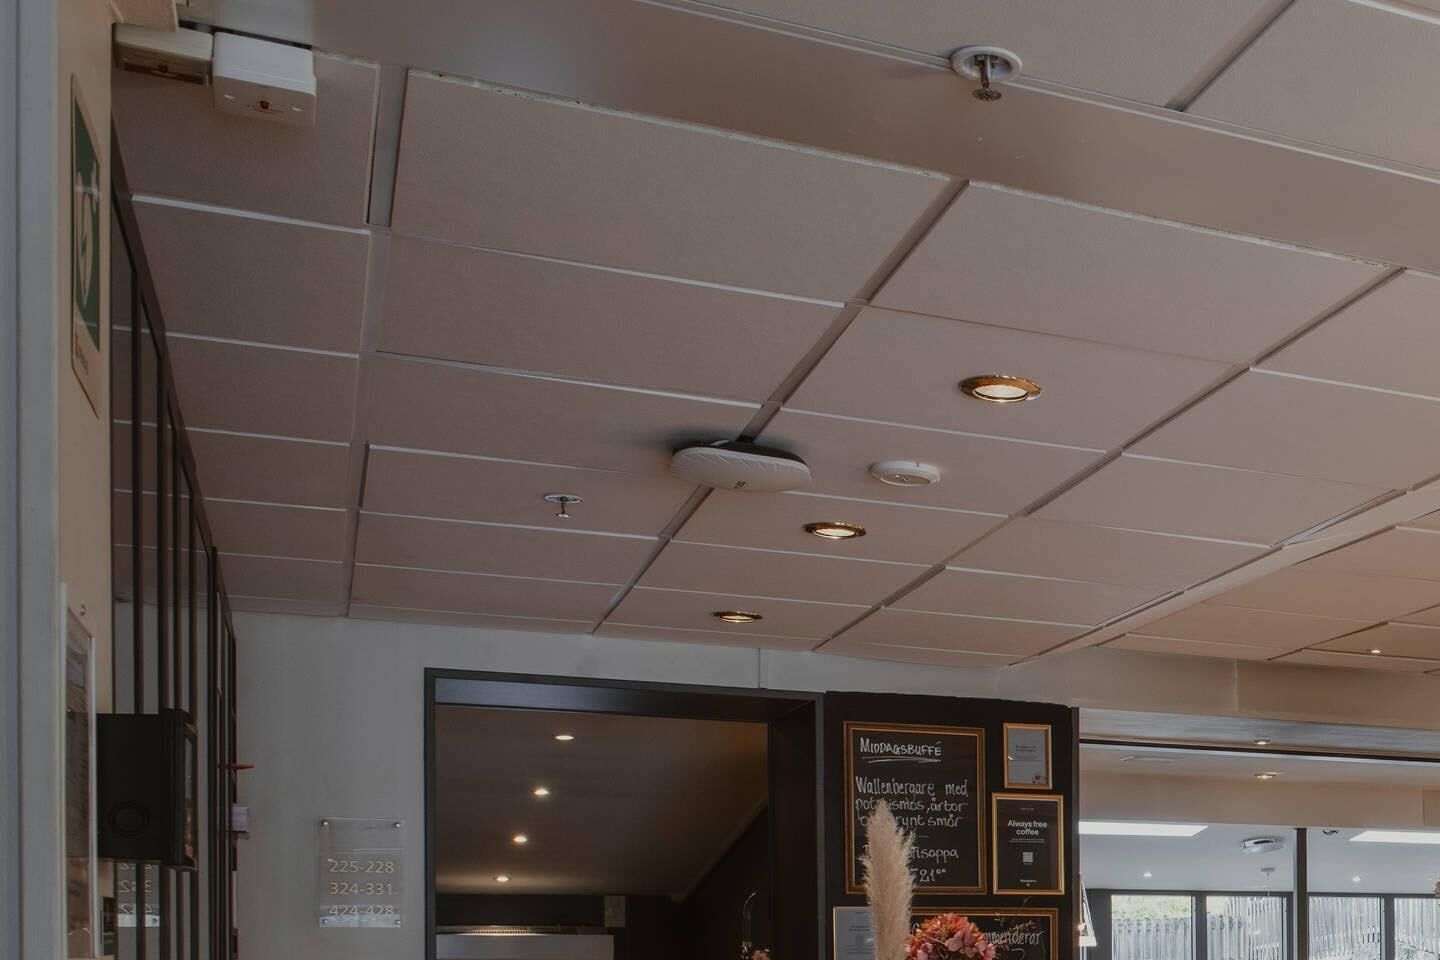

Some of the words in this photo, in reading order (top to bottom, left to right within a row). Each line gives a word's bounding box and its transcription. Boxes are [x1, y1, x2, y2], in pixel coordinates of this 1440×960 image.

[856, 776, 935, 802] Wallenbergare
[945, 778, 969, 797] med
[856, 798, 925, 820] potismos
[896, 815, 926, 831] rynt
[928, 814, 963, 827] smör
[1007, 819, 1032, 828] Always
[1032, 819, 1048, 828] free
[1015, 828, 1039, 836] coffee
[327, 860, 395, 874] 225-228
